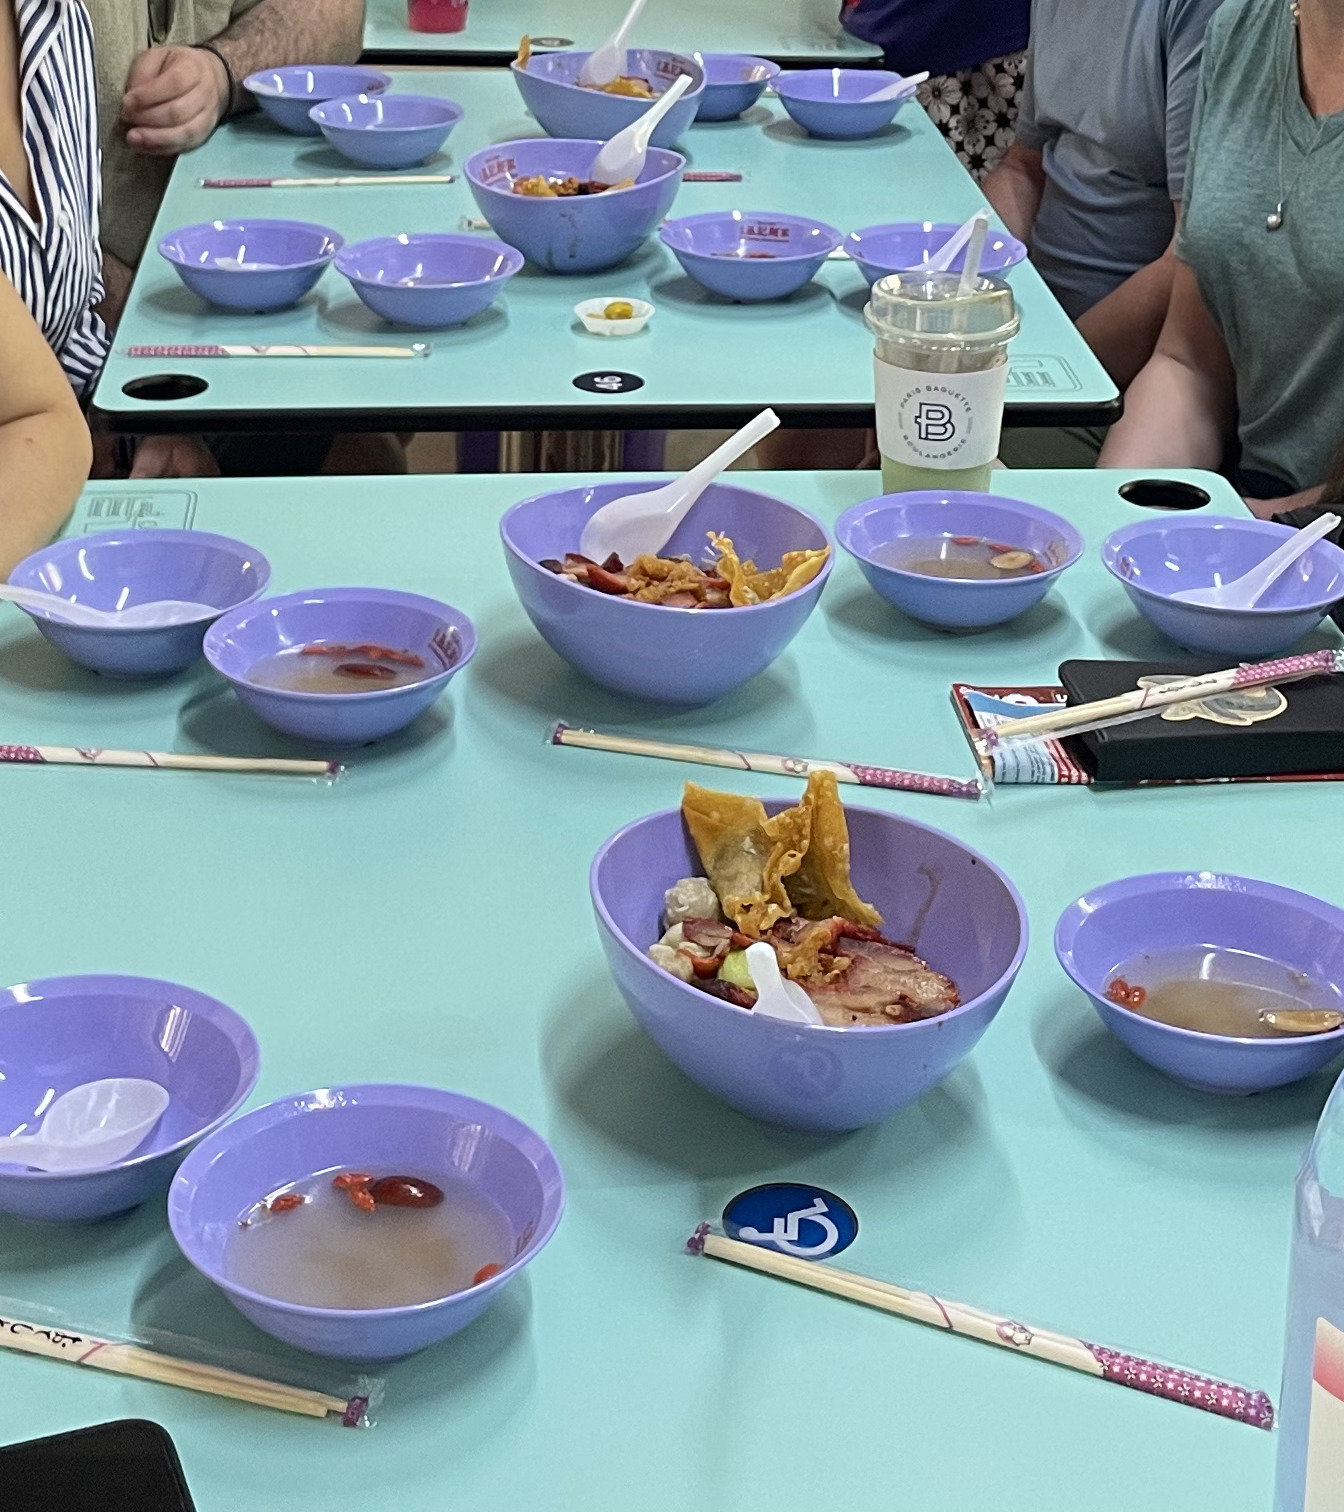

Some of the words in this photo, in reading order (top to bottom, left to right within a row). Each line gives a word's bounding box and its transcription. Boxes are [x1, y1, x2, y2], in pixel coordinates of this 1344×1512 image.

[593, 375, 623, 391] 46
[900, 388, 921, 409] PARIS
[925, 385, 972, 413] BAGUETTE
[903, 435, 966, 459] BOULANGERIE
